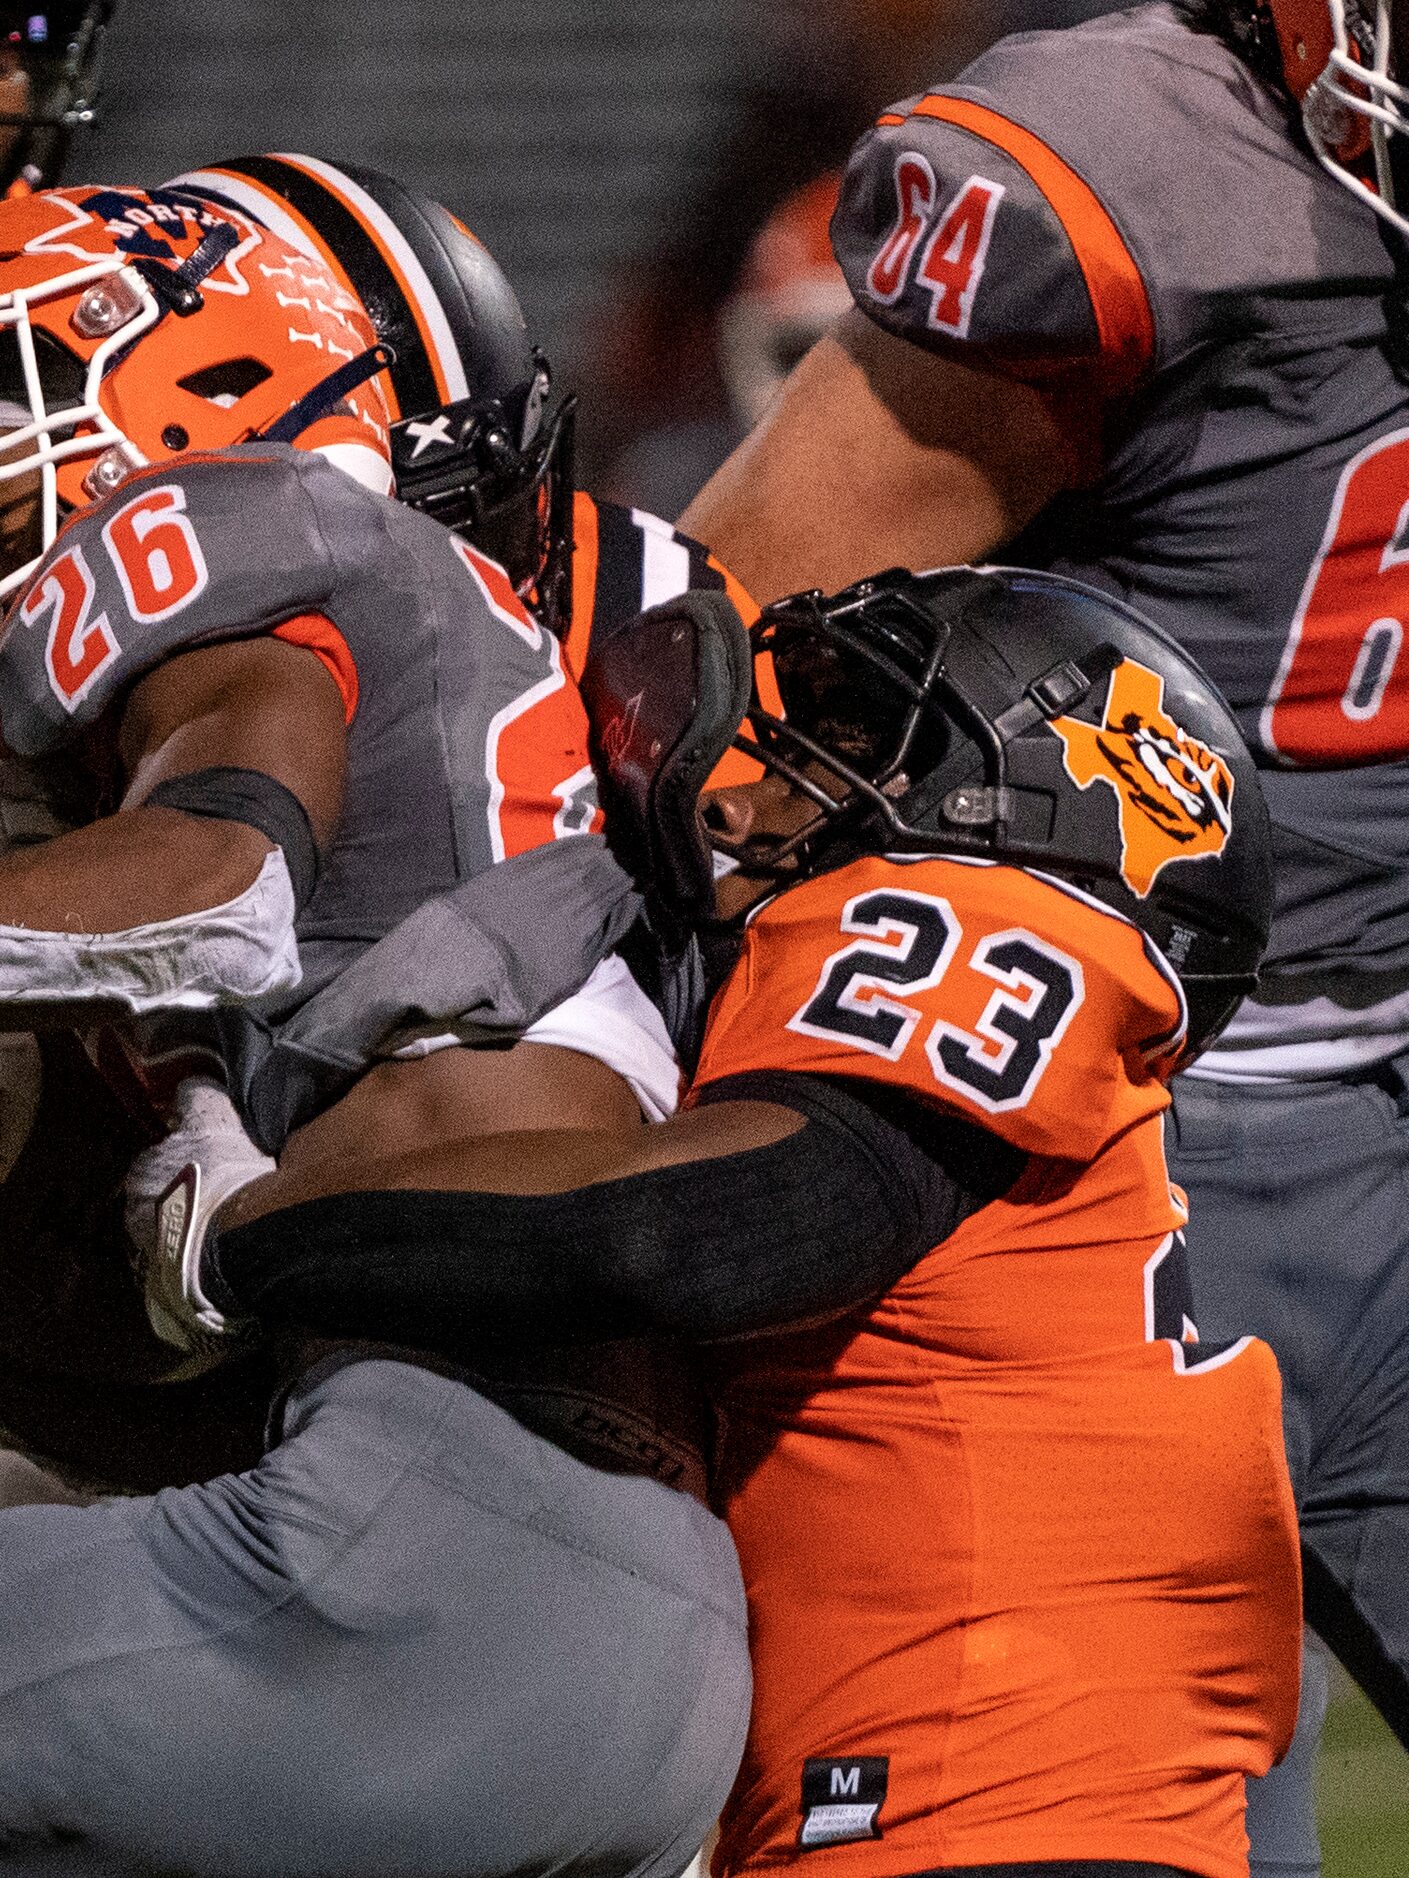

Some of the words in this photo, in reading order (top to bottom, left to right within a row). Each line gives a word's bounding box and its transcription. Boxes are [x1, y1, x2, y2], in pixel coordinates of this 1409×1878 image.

[866, 152, 1006, 339] 64
[20, 484, 208, 714] 26
[785, 887, 1086, 1114] 23
[830, 1766, 861, 1795] M
